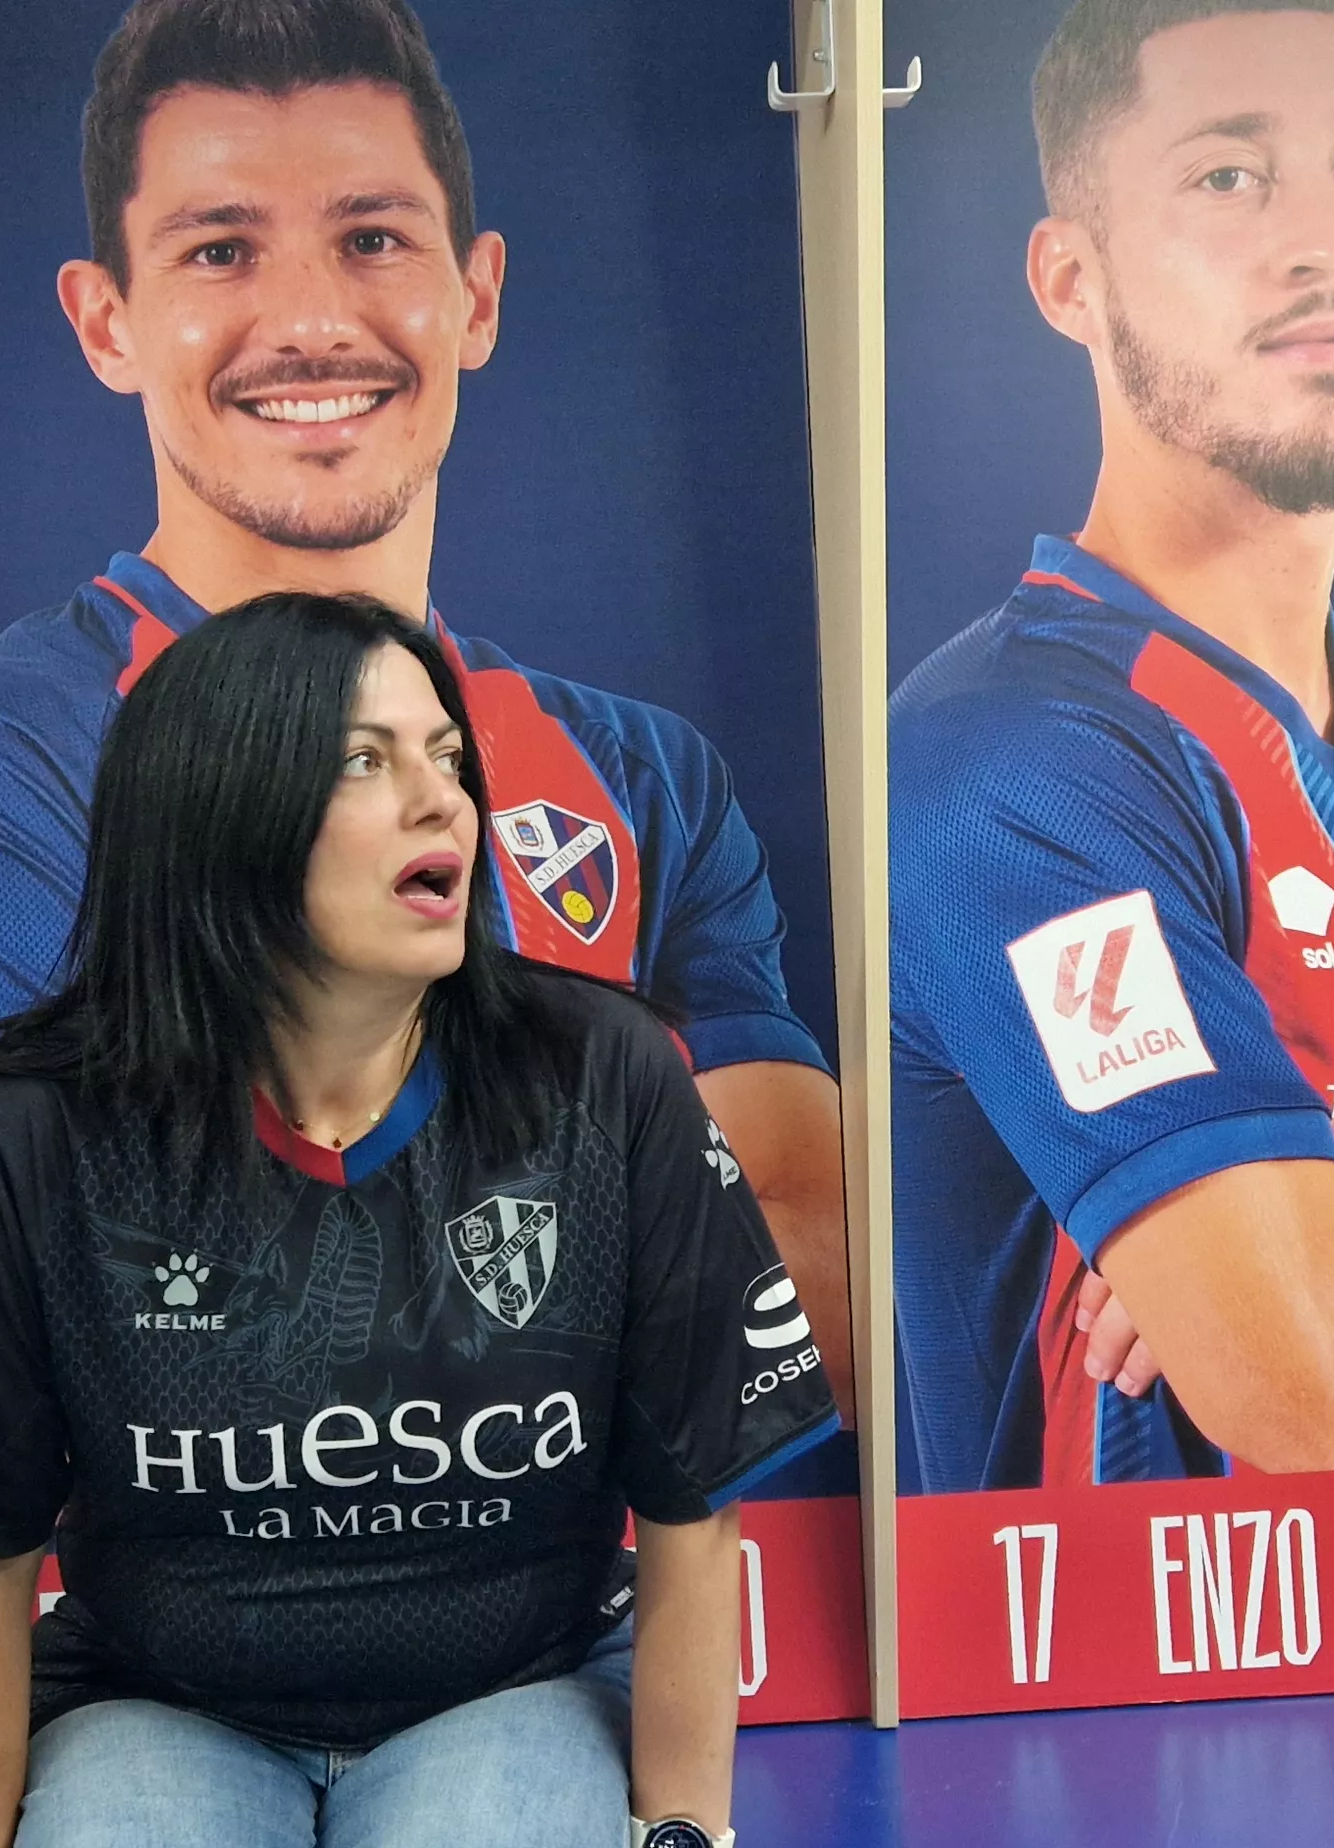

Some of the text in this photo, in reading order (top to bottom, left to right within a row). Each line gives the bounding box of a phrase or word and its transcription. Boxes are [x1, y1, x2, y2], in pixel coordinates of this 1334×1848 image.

[554, 832, 599, 870] HUESCA
[1078, 1027, 1187, 1085] LALIGA
[499, 1212, 551, 1262] HUESCA
[134, 1312, 227, 1331] KELME
[126, 1390, 588, 1494] Huesca
[993, 1522, 1058, 1686] 17
[1152, 1508, 1322, 1676] ENZO
